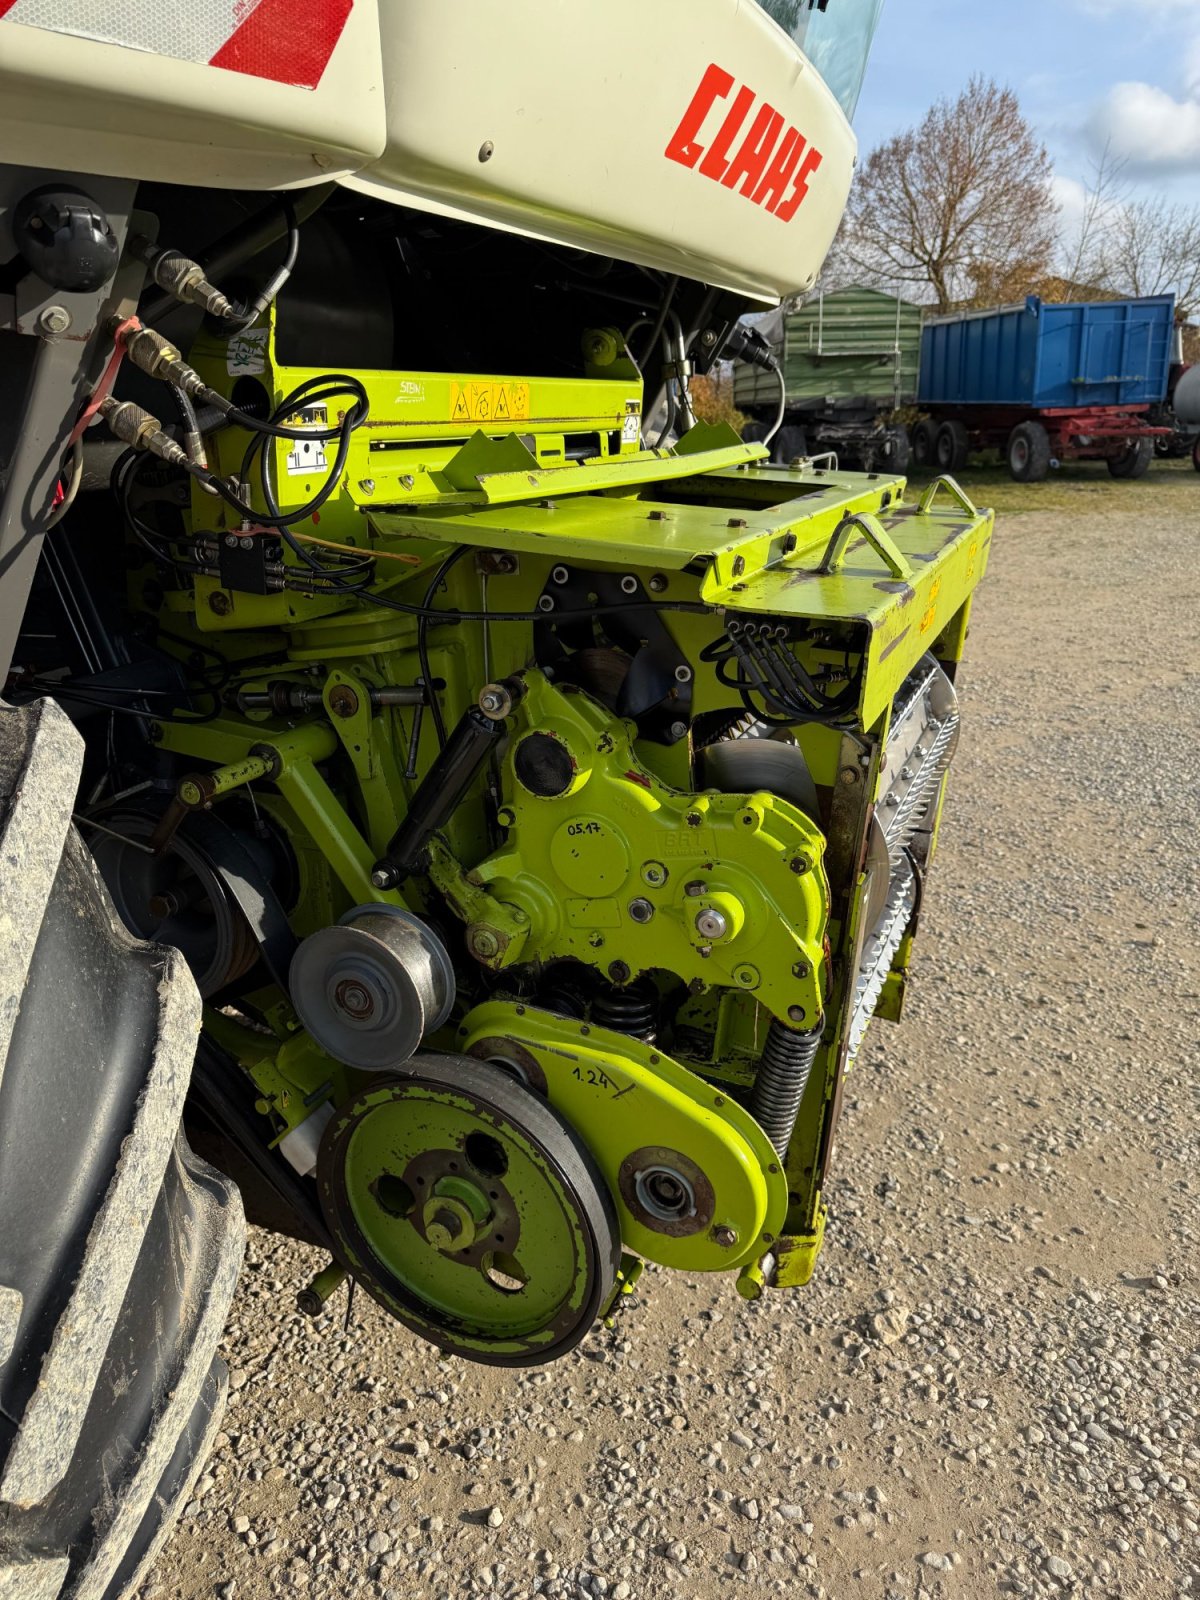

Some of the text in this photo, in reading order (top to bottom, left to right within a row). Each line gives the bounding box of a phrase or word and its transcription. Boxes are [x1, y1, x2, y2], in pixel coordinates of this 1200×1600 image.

[664, 63, 823, 223] CLAAS
[567, 822, 601, 836] 05.17
[572, 1066, 608, 1089] 1.24
